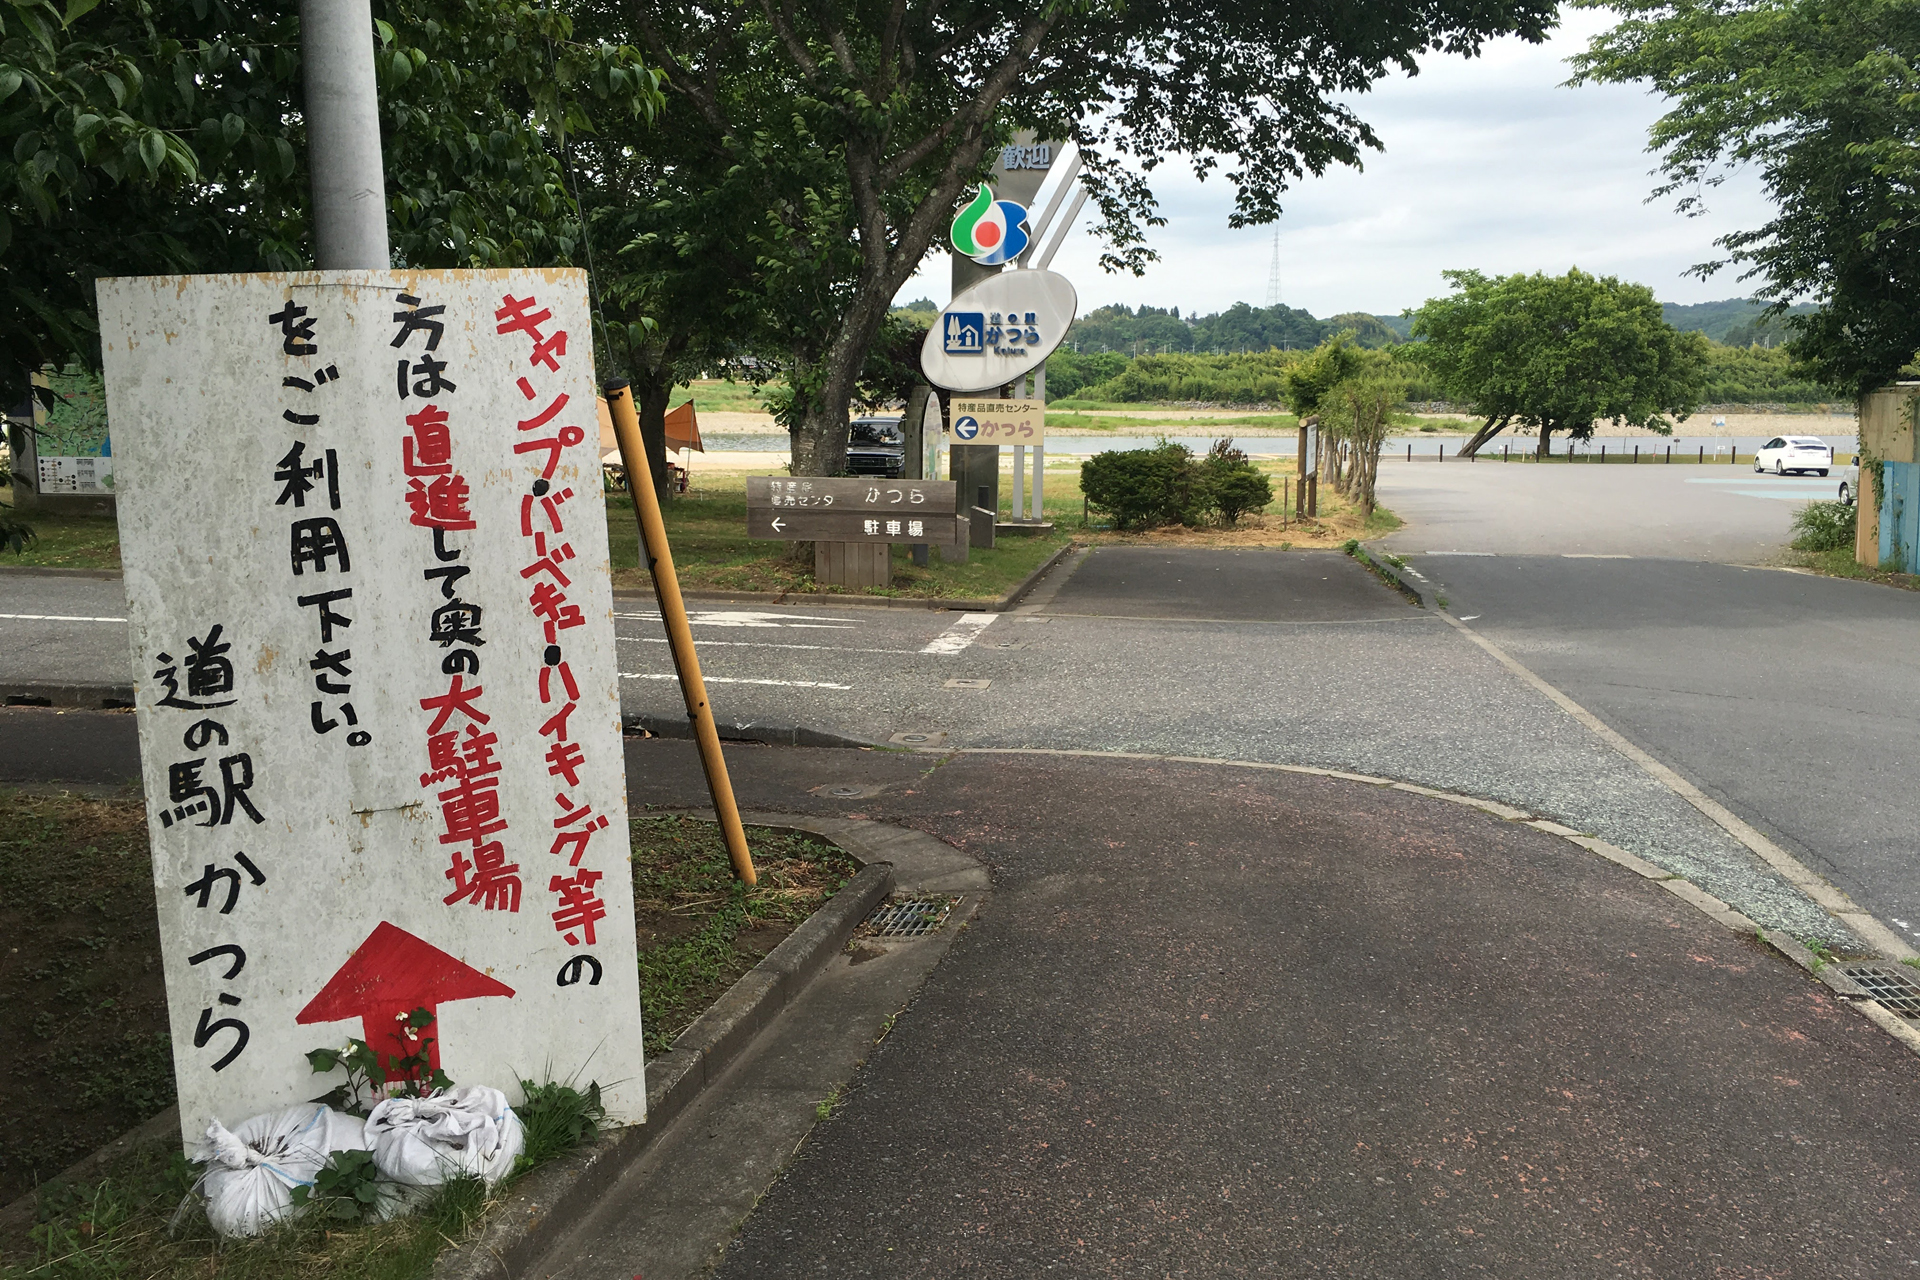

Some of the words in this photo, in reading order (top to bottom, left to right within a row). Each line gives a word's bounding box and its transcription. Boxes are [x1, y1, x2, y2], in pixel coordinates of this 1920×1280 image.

[985, 326, 1040, 345] かつら
[957, 403, 1038, 413] 特産品直売センター
[980, 420, 1034, 438] かつら
[865, 487, 925, 504] かつら
[268, 299, 372, 747] をご利用下さい。
[863, 519, 924, 537] 駐車場
[389, 292, 523, 913] 方は直進して奥の大駐車場
